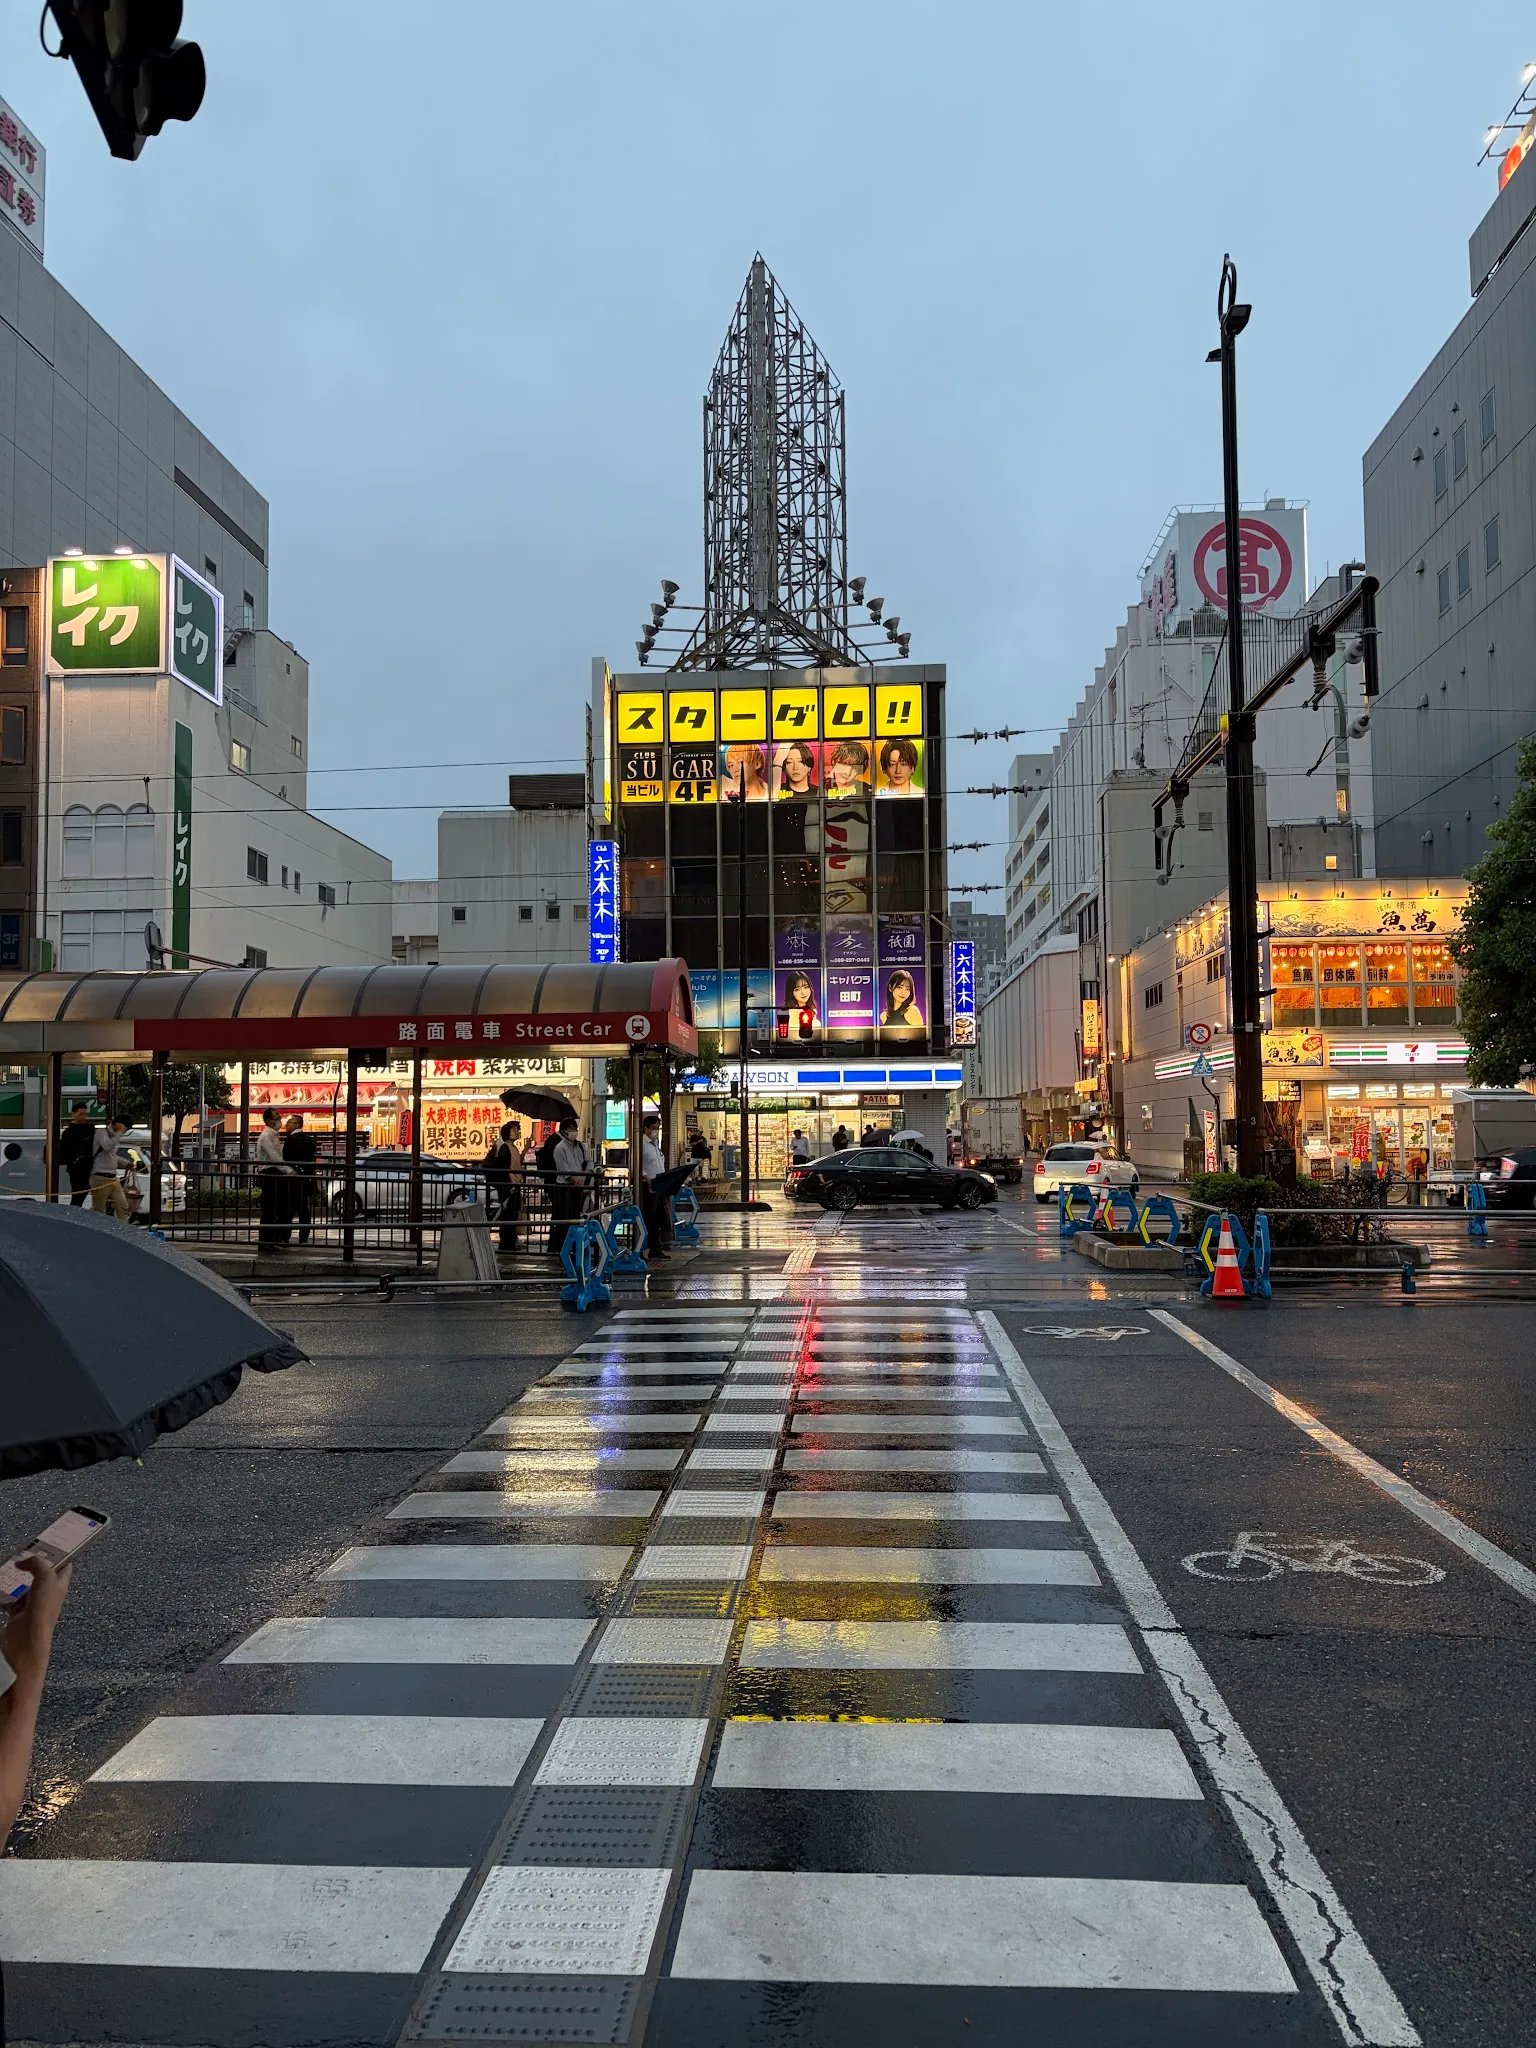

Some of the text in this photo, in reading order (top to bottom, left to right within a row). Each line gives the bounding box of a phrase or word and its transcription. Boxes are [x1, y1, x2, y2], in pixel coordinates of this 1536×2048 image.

[634, 752, 656, 760] CLUB
[626, 784, 660, 797] 当ビル
[675, 781, 712, 802] 4F
[174, 809, 188, 887] レイク
[591, 855, 614, 924] 六本木
[1376, 909, 1437, 933] 魚萬
[955, 953, 973, 1009] 六本木
[1292, 968, 1313, 982] 魚萬
[1323, 968, 1356, 982] 団体席
[839, 991, 861, 1003] 田町
[398, 1021, 612, 1041] 路面電車 Street Car
[433, 1059, 476, 1077] 焼肉
[868, 1095, 887, 1104] ATM
